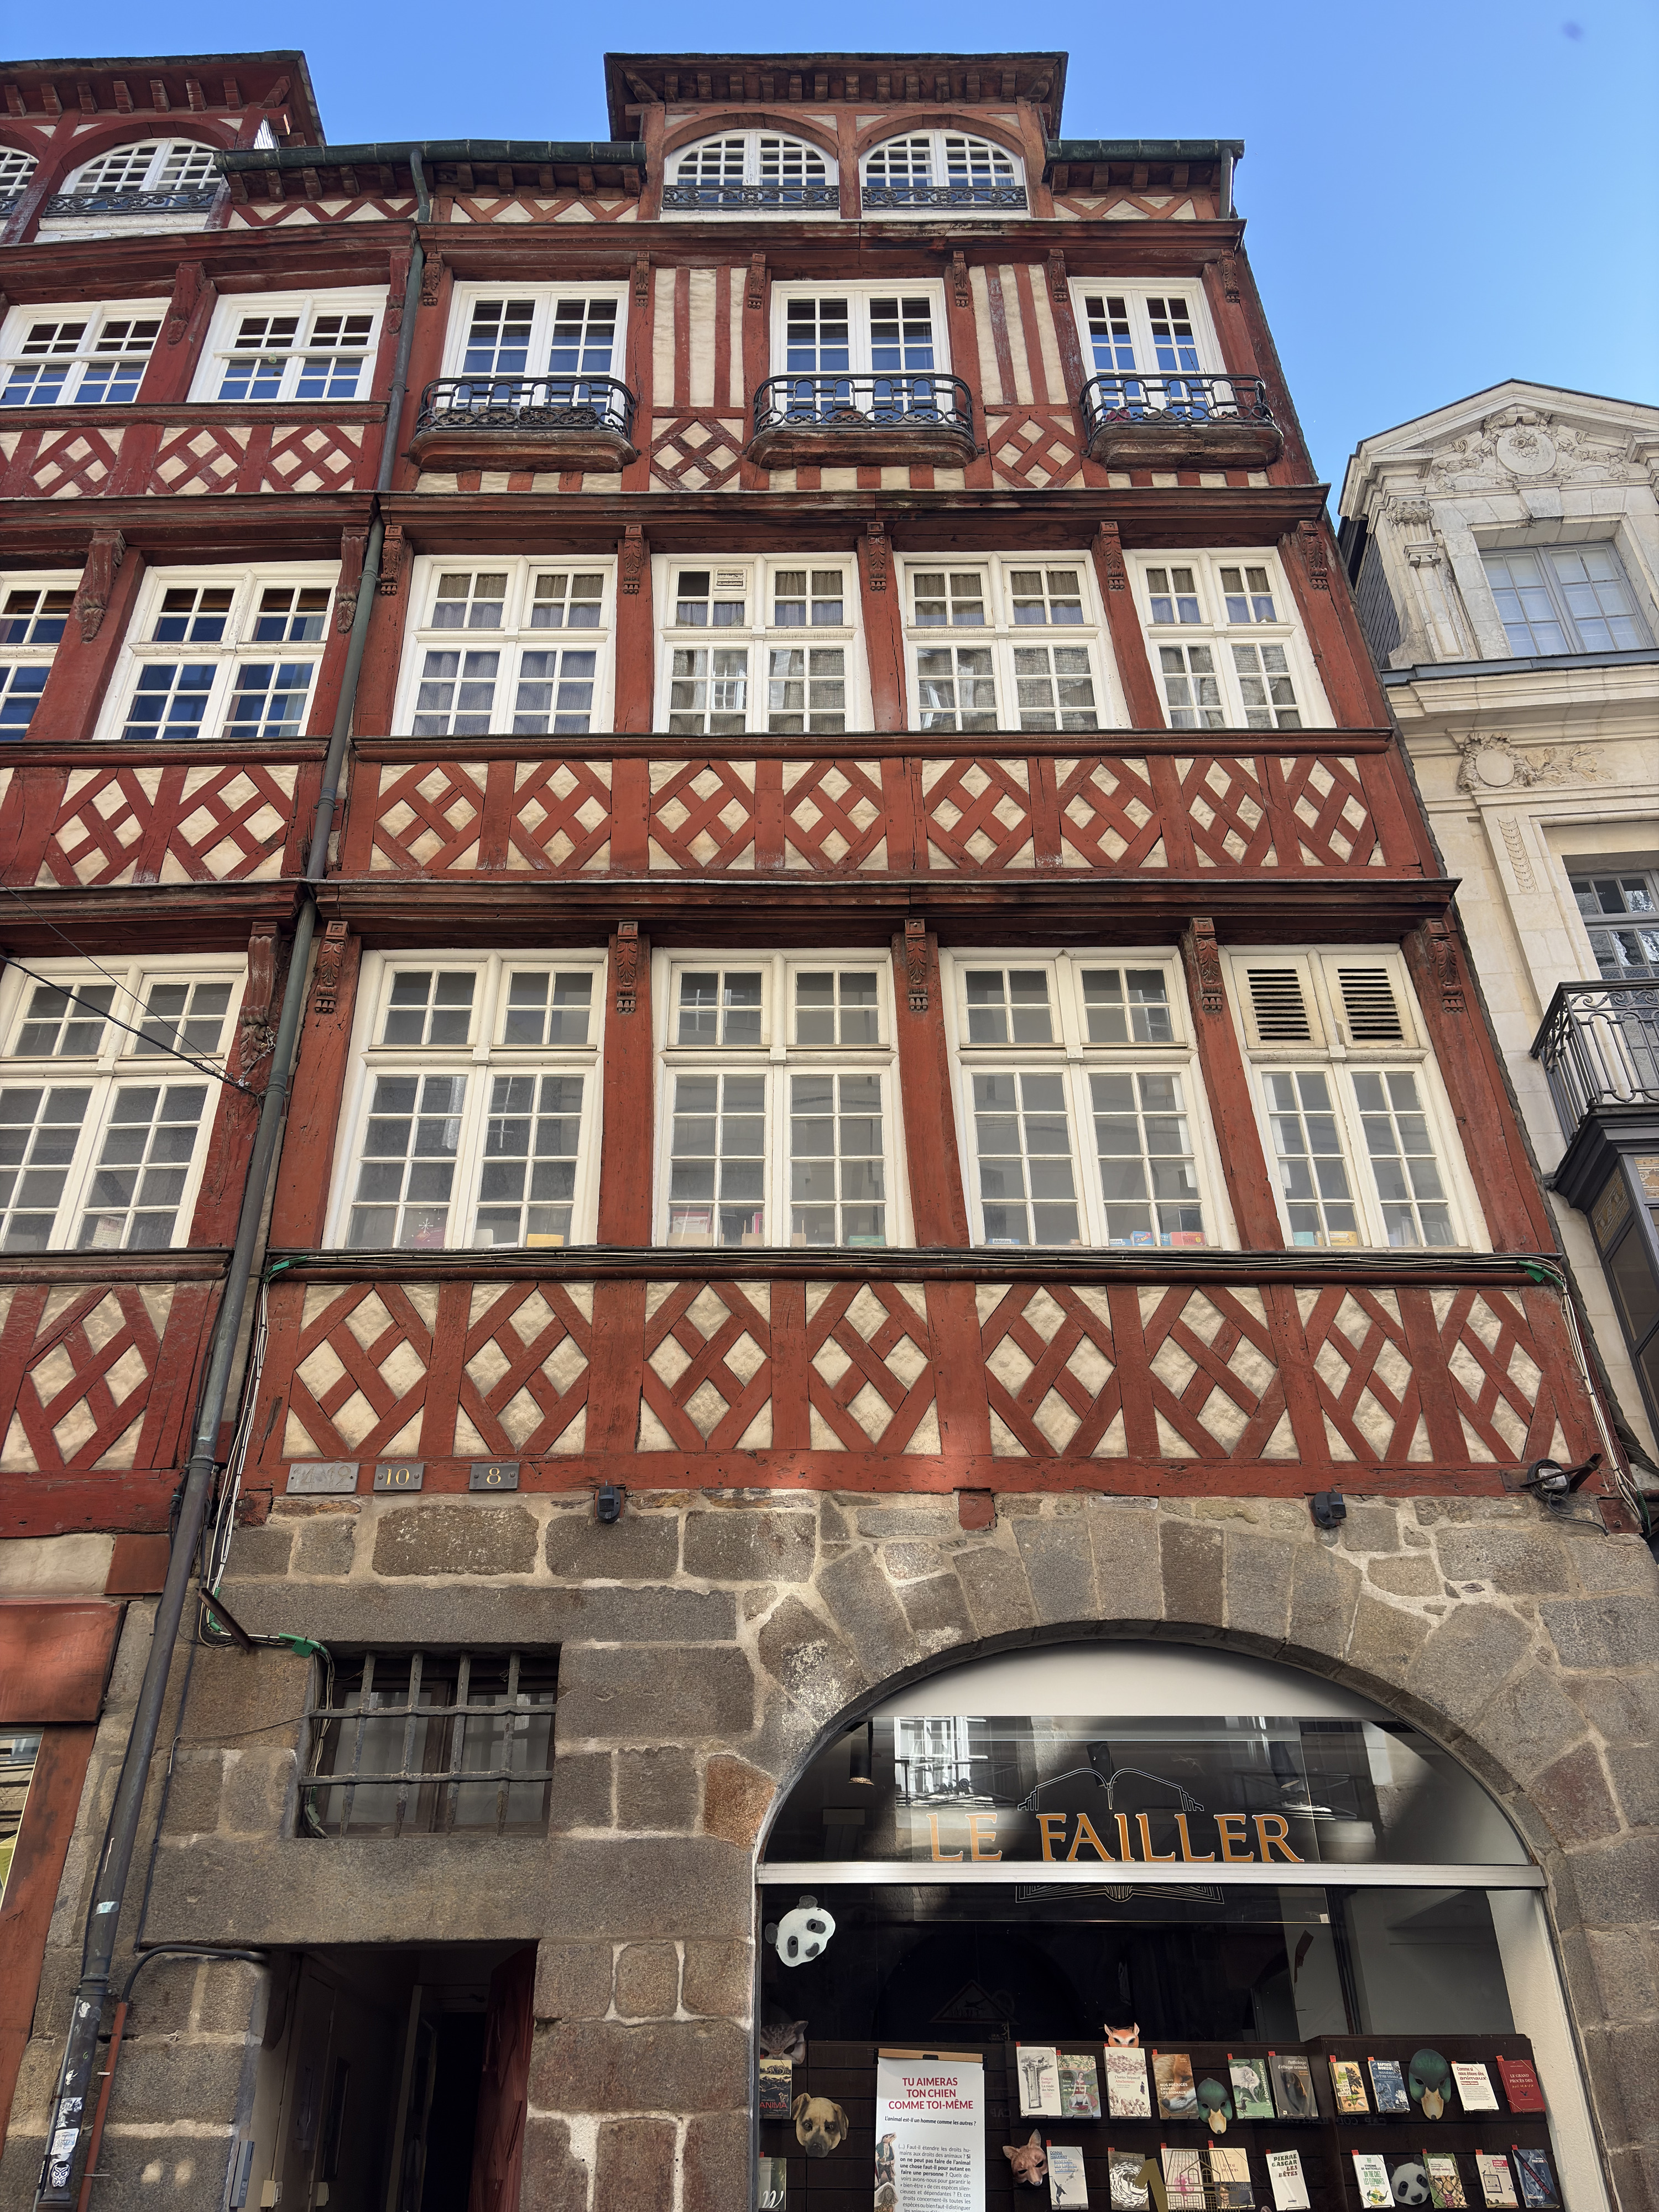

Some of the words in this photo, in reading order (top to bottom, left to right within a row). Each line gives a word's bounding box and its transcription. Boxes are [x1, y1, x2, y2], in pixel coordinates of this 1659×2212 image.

[327, 1465, 352, 1489] 12
[386, 1468, 410, 1486] 10
[486, 1467, 502, 1485] 8
[926, 1813, 1003, 1862] LE
[1036, 1813, 1305, 1863] FAILLER
[902, 2078, 914, 2086] TU
[916, 2078, 958, 2086] AIMERAS
[1259, 2062, 1269, 2099] domestication
[906, 2089, 926, 2098] TON
[927, 2089, 956, 2098] CHIEN
[889, 2101, 925, 2109] COMME
[926, 2099, 973, 2109] TOI-MÊME
[1273, 2153, 1297, 2162] PIERRE
